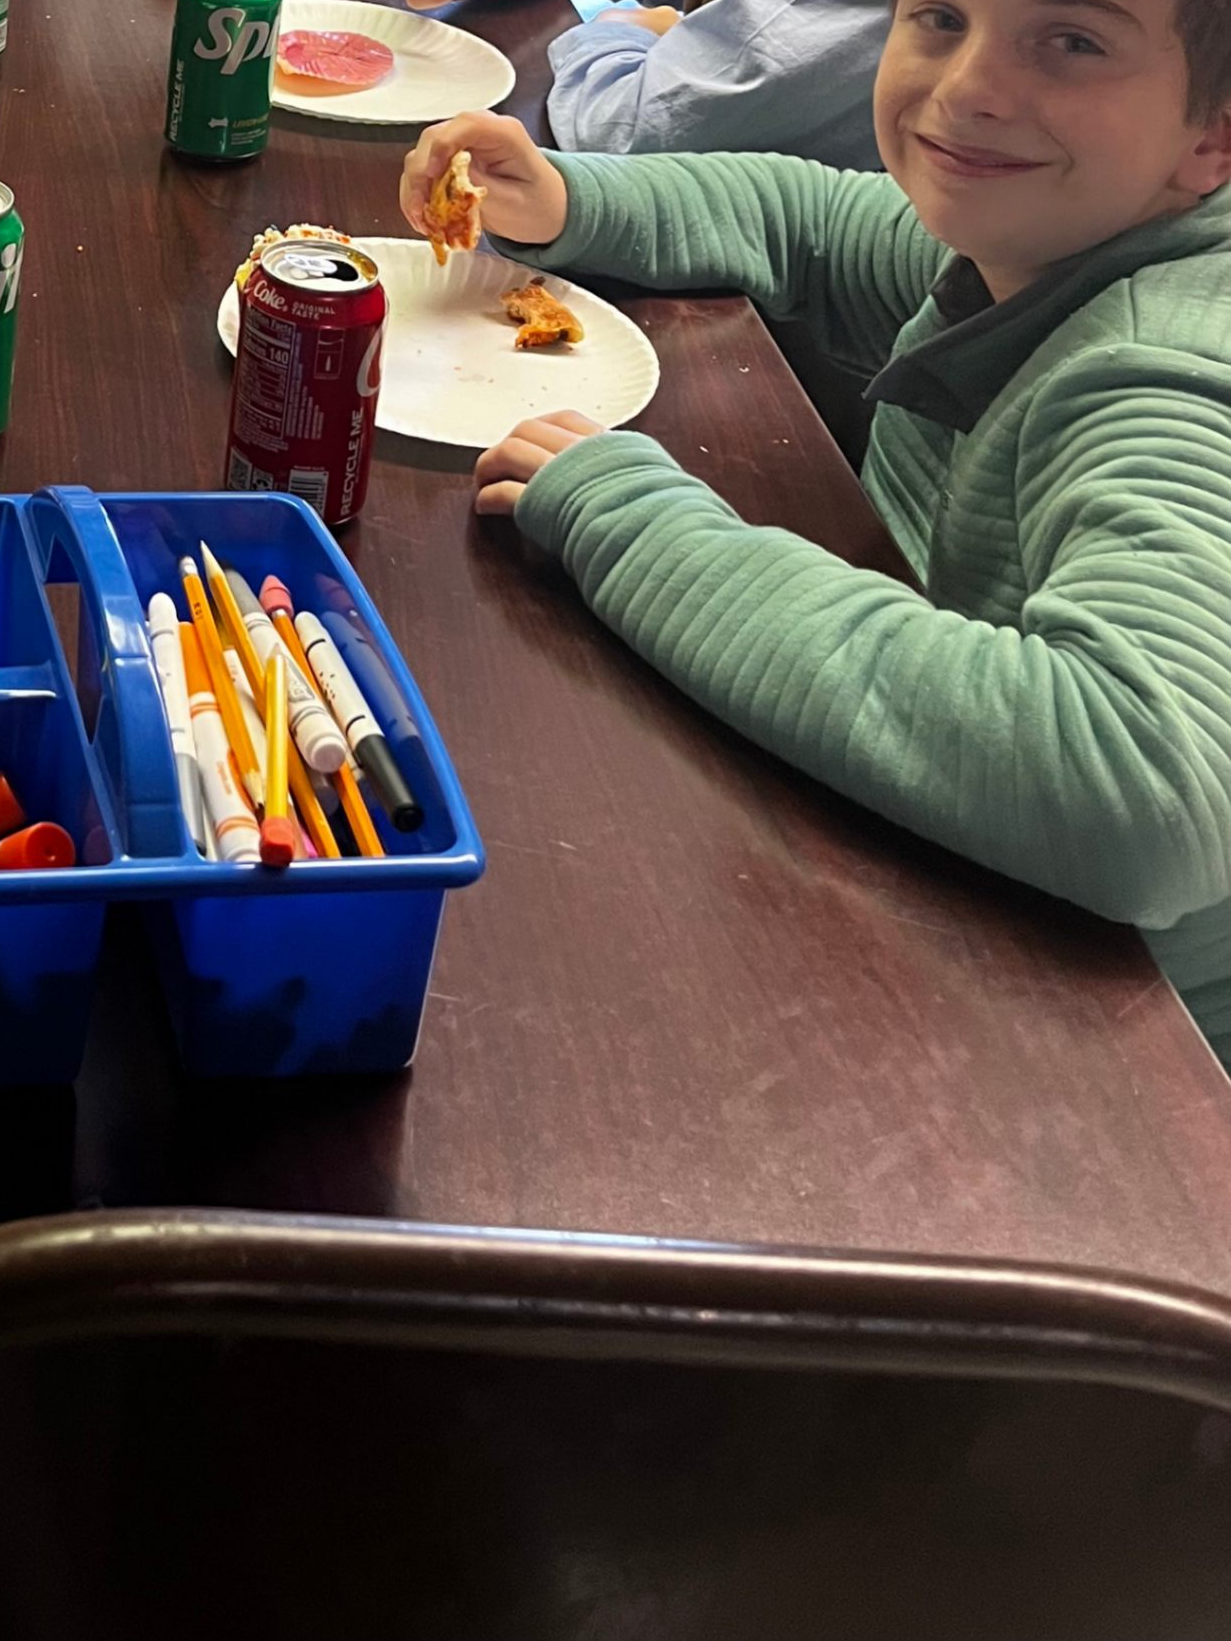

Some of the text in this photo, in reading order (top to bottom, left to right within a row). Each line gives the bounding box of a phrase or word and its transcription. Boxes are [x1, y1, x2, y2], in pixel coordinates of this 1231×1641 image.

[170, 59, 185, 142] RECYCLE ME
[253, 279, 285, 310] Coke
[291, 308, 320, 320] TASTE
[292, 301, 336, 315] ORIGINAL
[270, 347, 289, 364] 140
[341, 439, 358, 516] RECYCLE
[352, 406, 364, 434] ME
